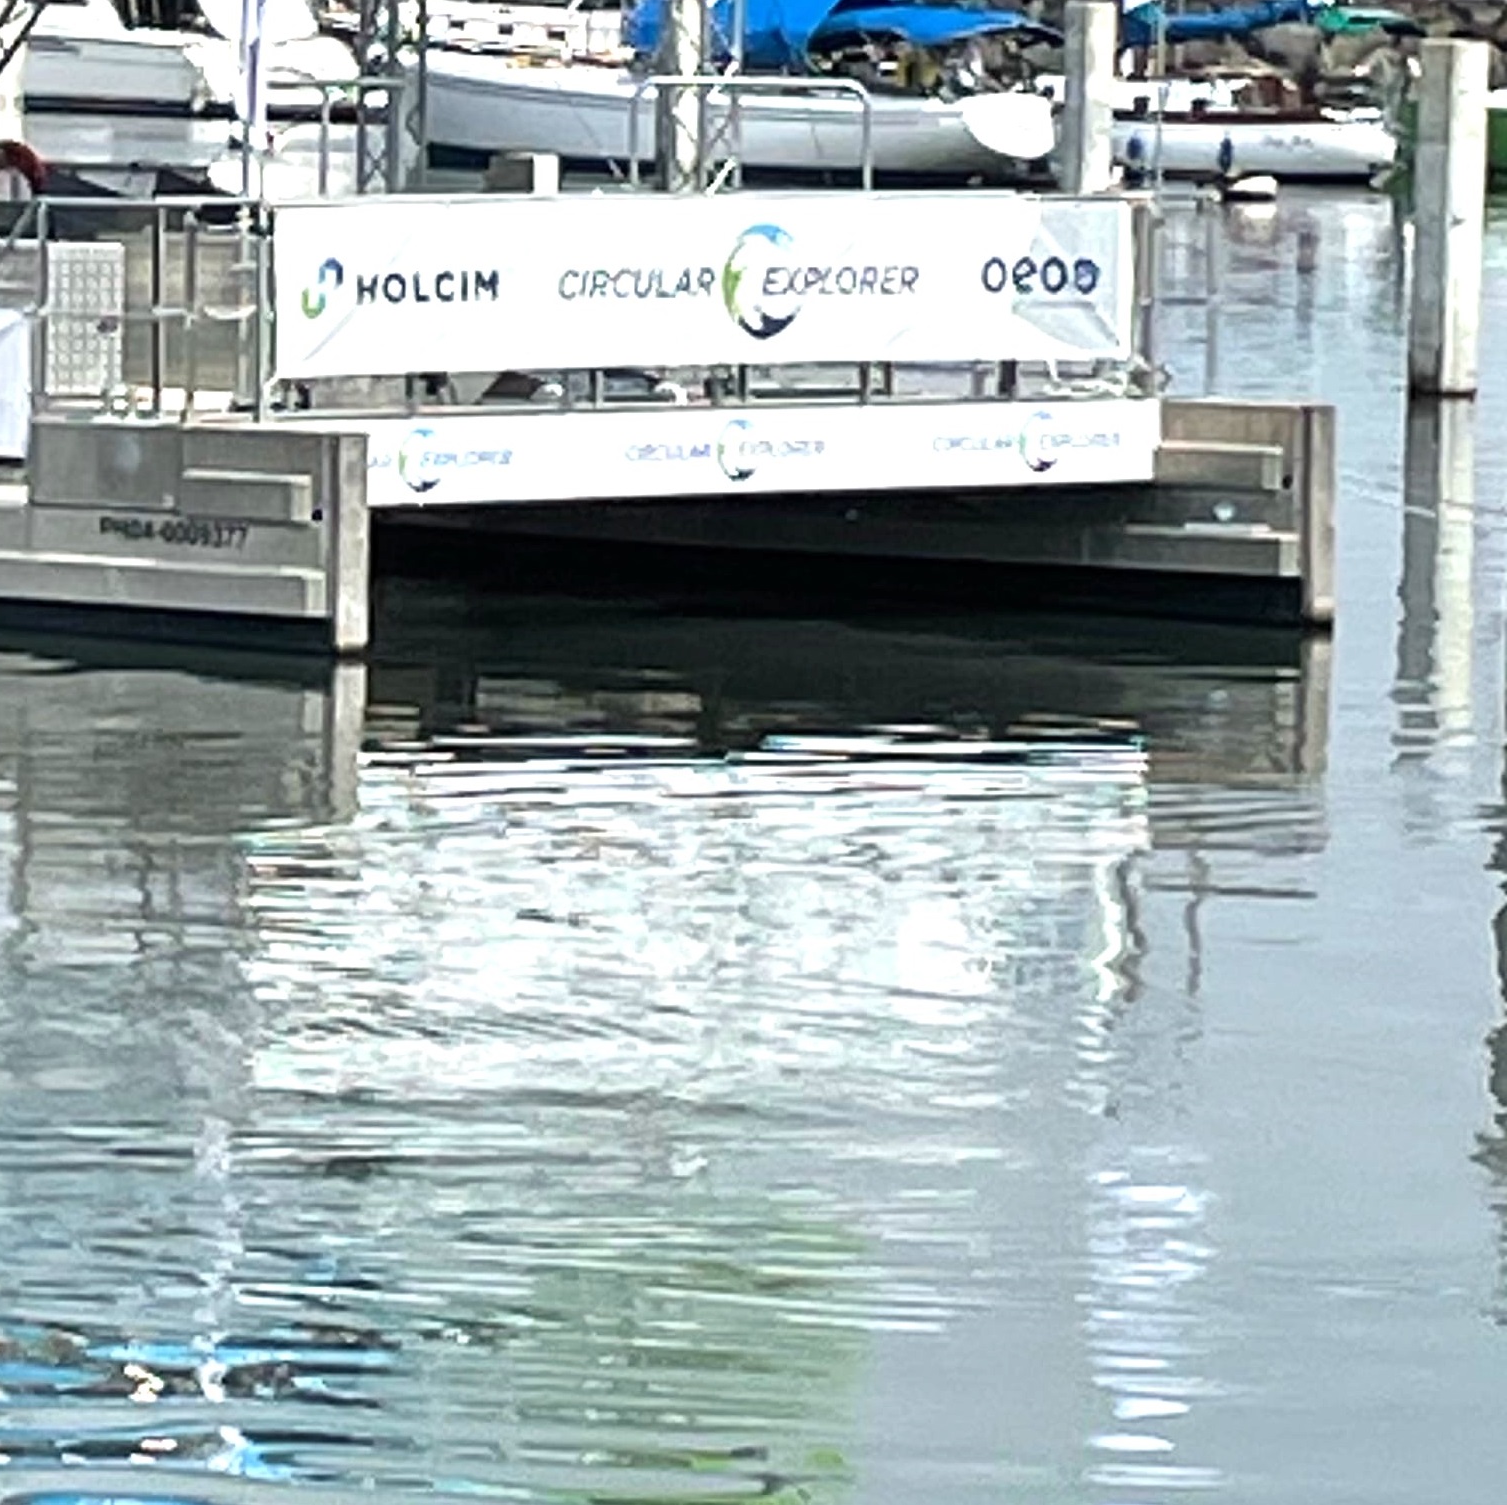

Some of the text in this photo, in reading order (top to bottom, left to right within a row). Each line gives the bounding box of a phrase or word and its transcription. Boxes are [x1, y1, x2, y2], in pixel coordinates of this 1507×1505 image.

[356, 269, 499, 303] HOLCIM
[558, 267, 715, 300] CIRCULAR
[762, 265, 920, 297] EXPLORER
